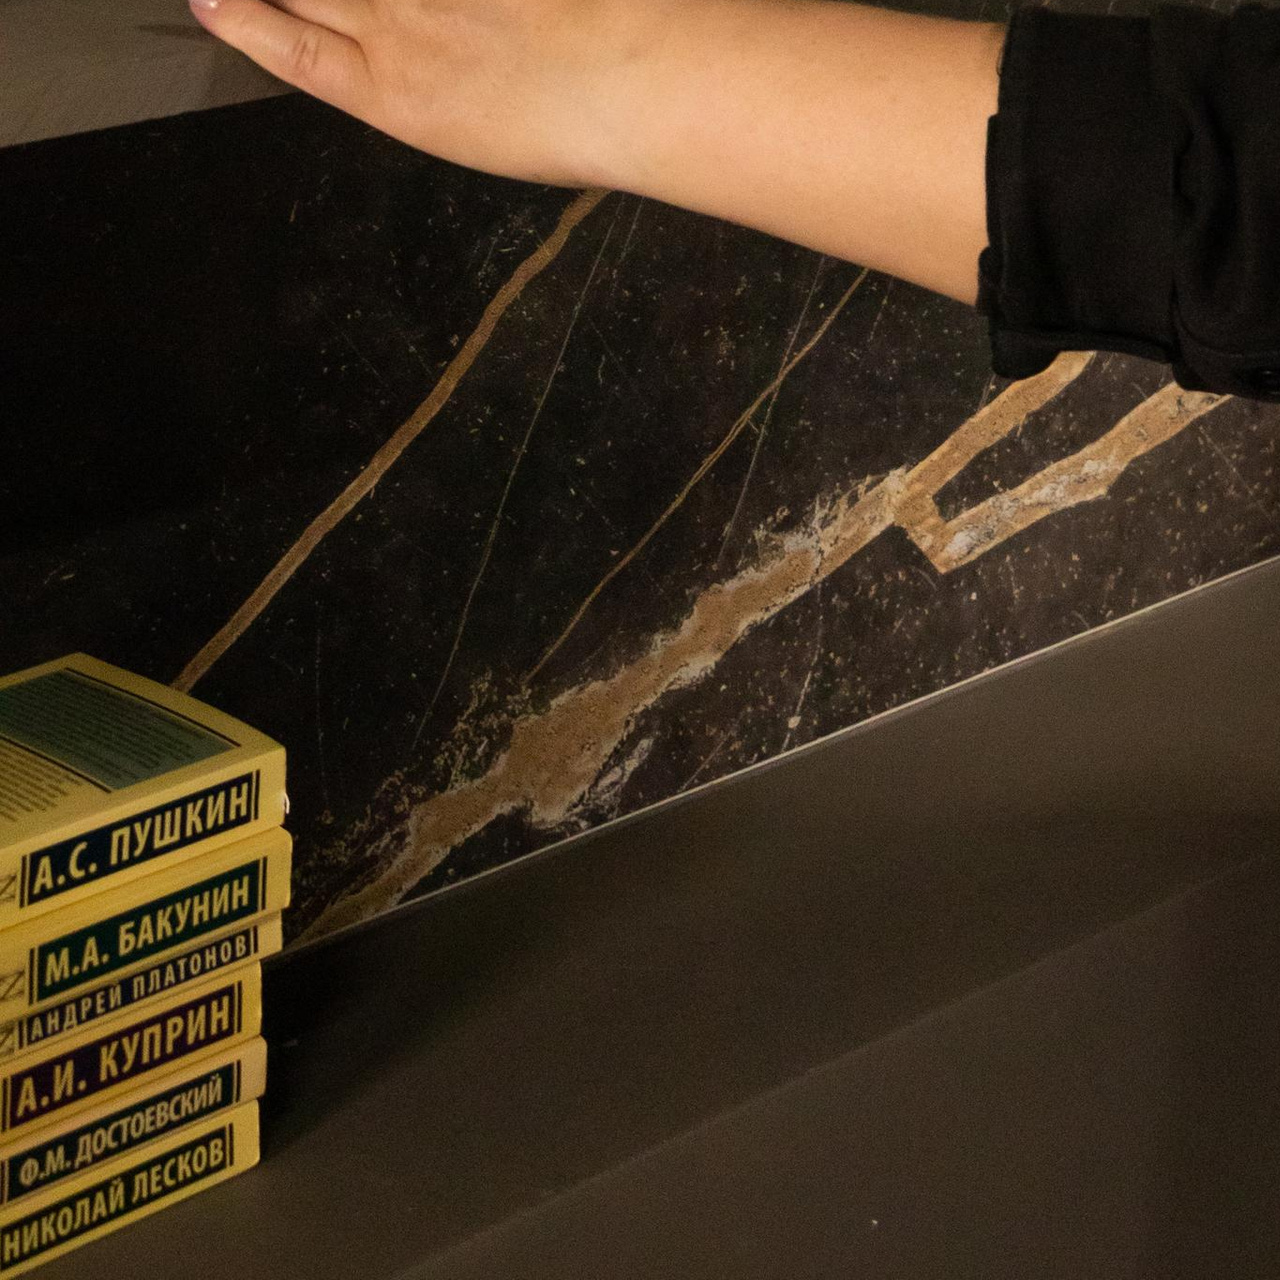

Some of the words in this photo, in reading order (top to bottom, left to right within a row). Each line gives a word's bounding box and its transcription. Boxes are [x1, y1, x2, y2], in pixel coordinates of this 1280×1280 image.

[33, 841, 97, 894] А.С.
[110, 782, 249, 865] ПУШКИН
[44, 936, 109, 986] М.А.
[118, 875, 249, 956] БАКУНИН
[31, 981, 121, 1040] АНДРЕЙ
[133, 935, 247, 999] ПЛАТОНОВ
[17, 1059, 87, 1118] А.И.
[100, 995, 229, 1082] КУПРИН
[19, 1146, 72, 1187] Ф.М.
[75, 1073, 222, 1170] ДОСТОЕВСКИЙ
[2, 1177, 125, 1263] НИКОЛАЙ
[132, 1138, 224, 1204] ЛЕСКОВ
